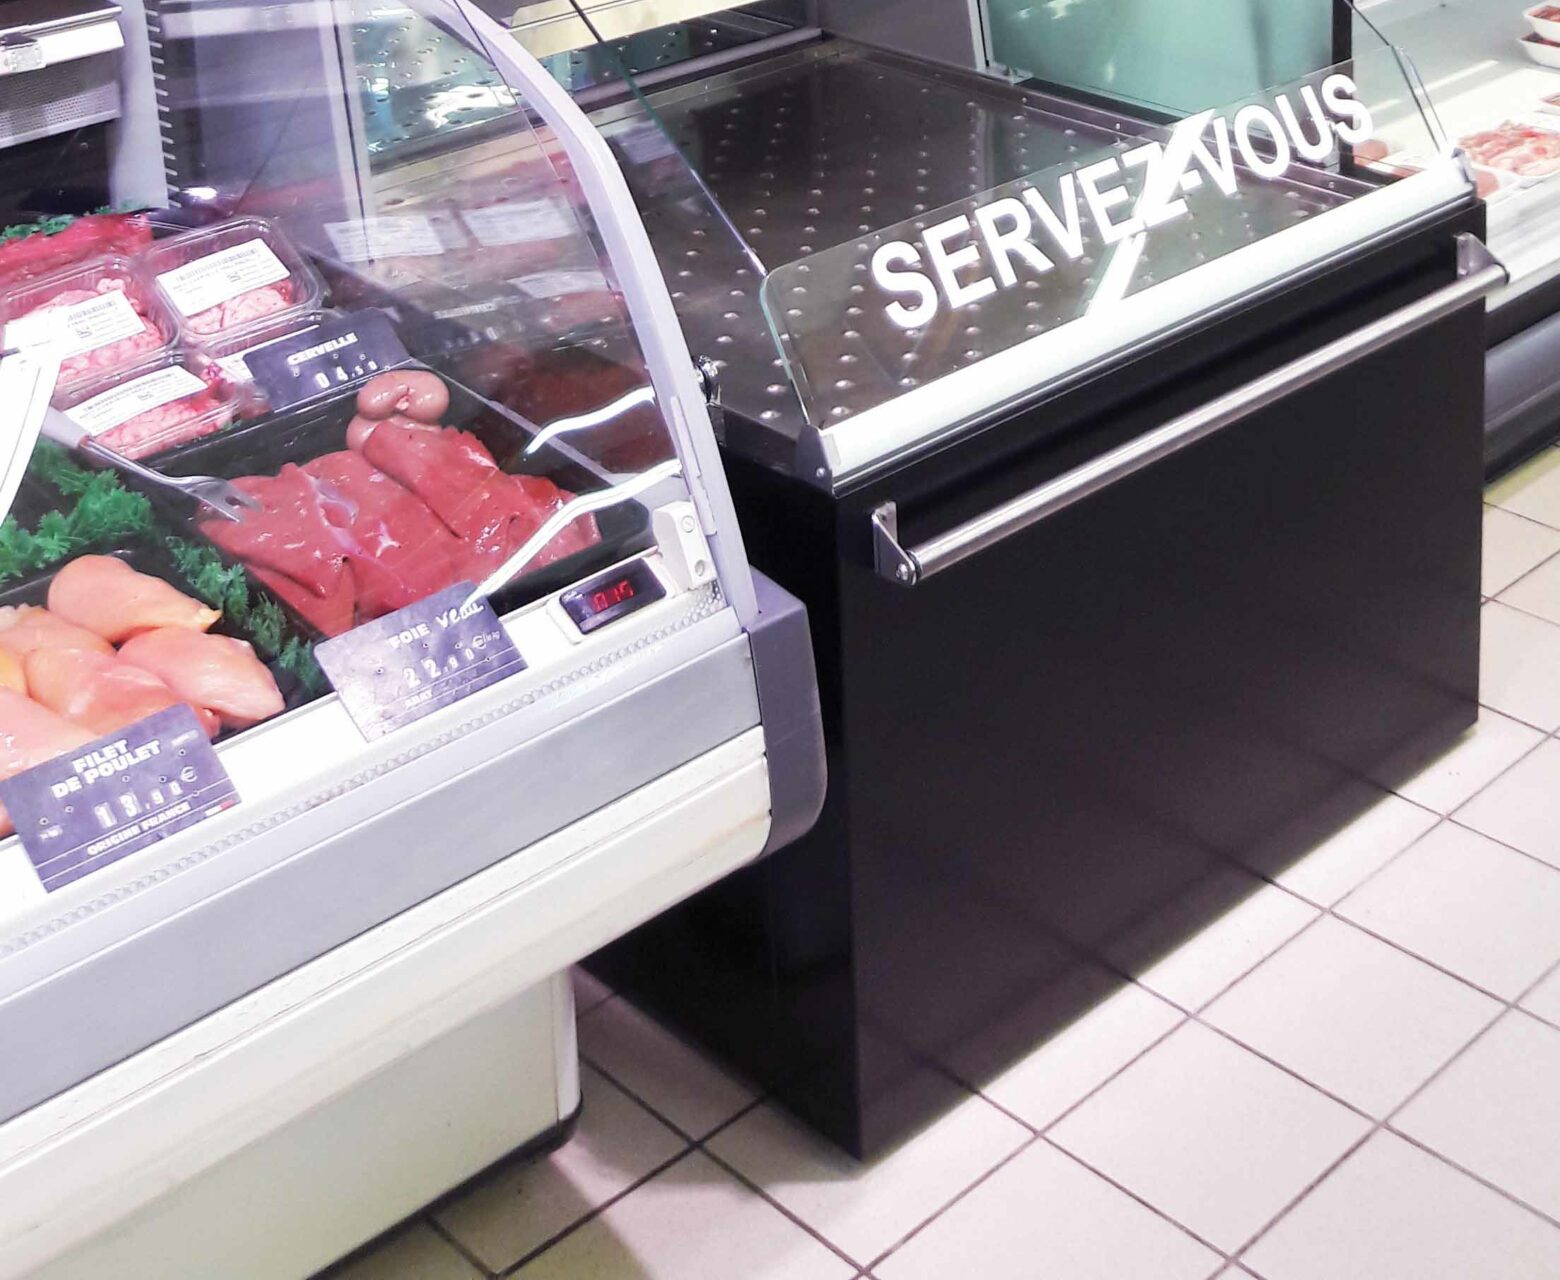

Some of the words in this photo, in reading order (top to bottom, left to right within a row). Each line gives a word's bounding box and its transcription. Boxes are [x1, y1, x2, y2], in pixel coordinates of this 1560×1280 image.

[287, 332, 359, 365] CERVELLE
[387, 623, 431, 649] FOIE
[51, 776, 83, 799] DE
[83, 740, 162, 784] POULET
[72, 739, 129, 773] FILET
[86, 824, 142, 856] ORIGINE
[140, 801, 192, 832] FRANCE
